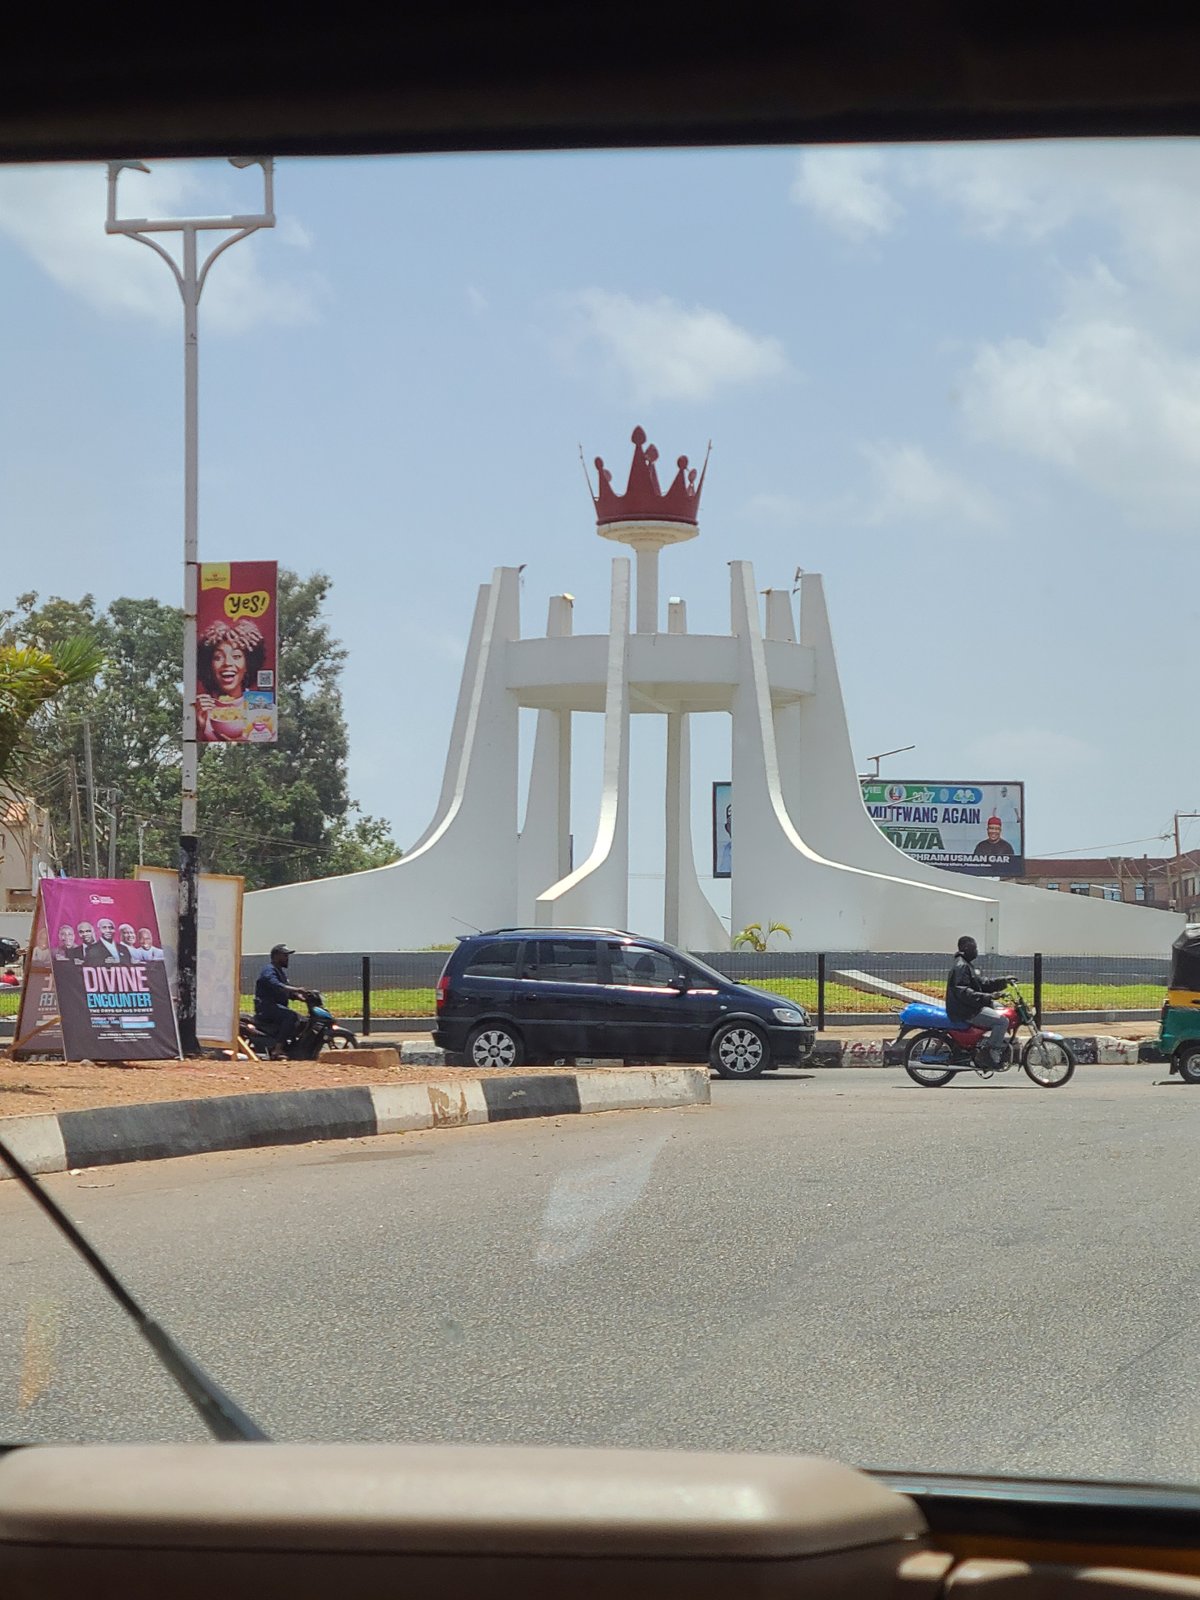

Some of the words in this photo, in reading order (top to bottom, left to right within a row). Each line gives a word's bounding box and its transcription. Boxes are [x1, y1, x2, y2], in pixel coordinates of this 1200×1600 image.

[942, 807, 981, 824] AGAIN
[950, 854, 987, 863] USMAN
[988, 855, 1010, 863] GAR
[82, 966, 150, 993] DIVINE
[86, 992, 152, 1008] ENCOUNTER
